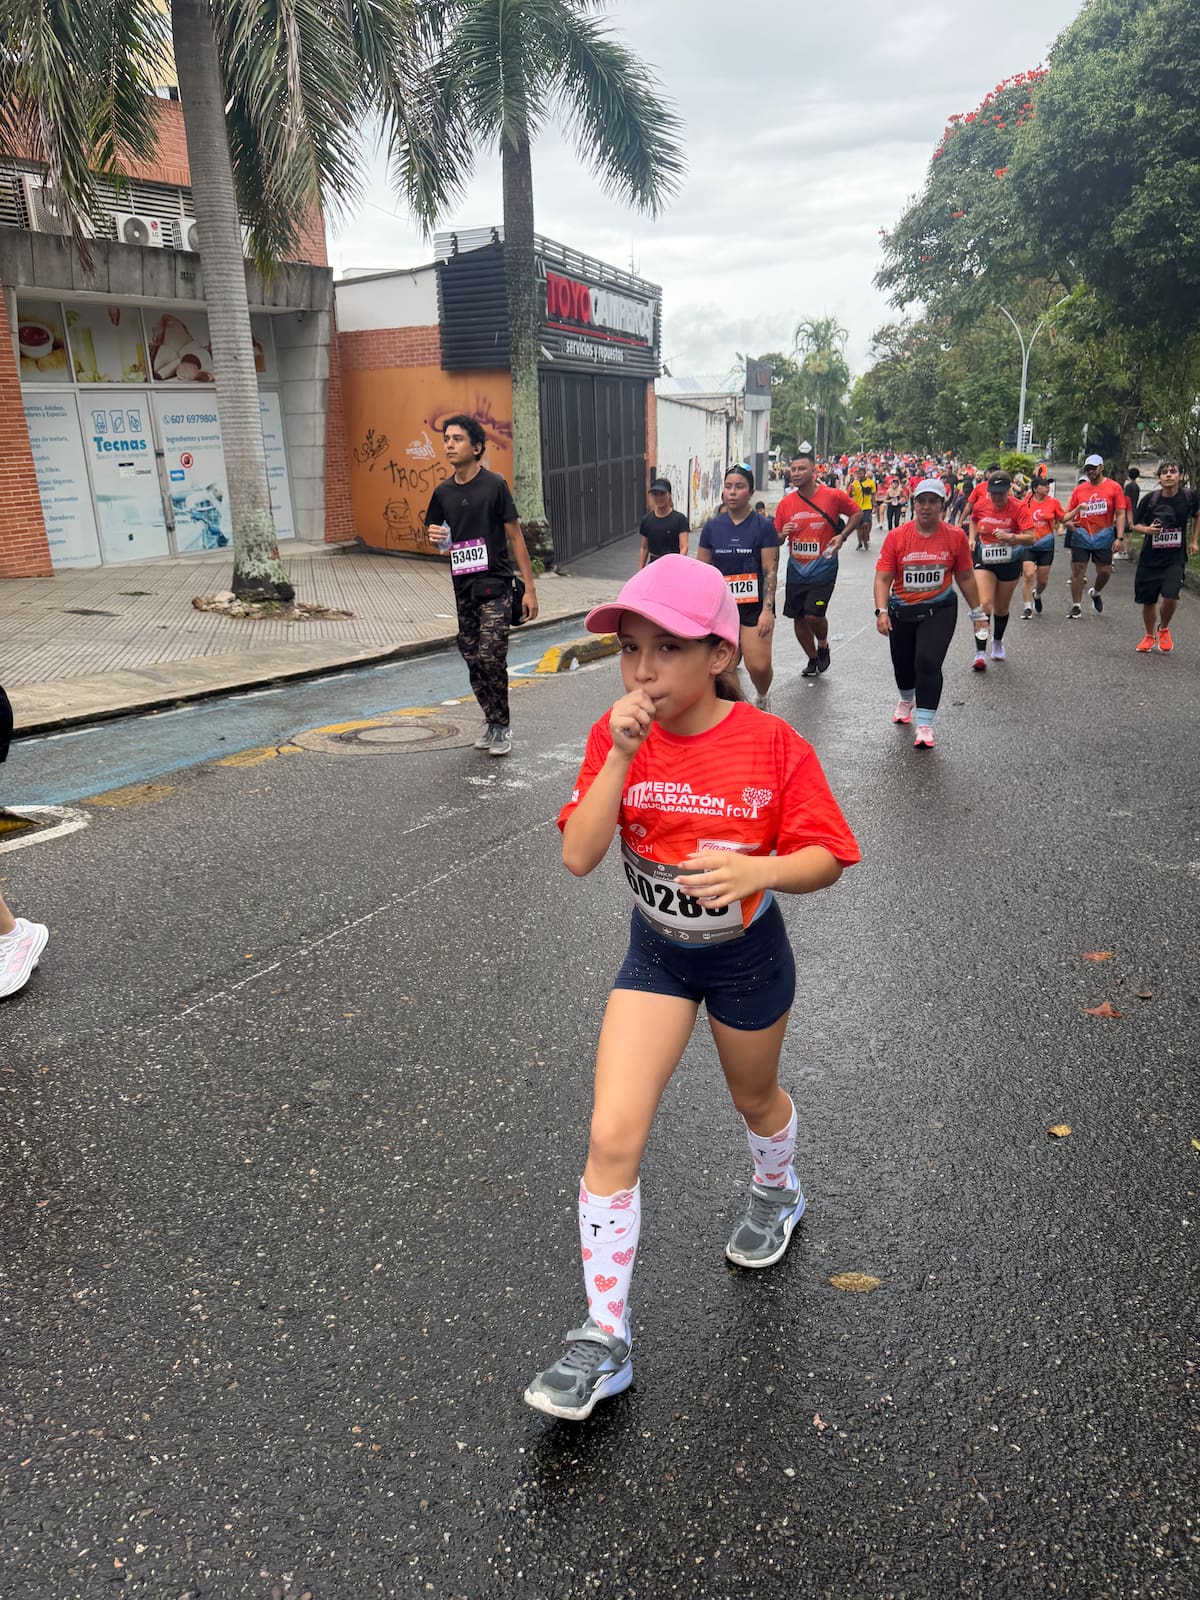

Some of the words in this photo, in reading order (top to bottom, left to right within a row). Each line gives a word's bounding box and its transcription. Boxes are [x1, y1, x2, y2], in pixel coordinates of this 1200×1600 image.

[171, 414, 185, 424] 607
[93, 436, 147, 452] Tecnas
[1154, 532, 1178, 542] 54074
[793, 542, 818, 552] 50019
[985, 547, 1008, 558] 61115
[452, 547, 484, 565] 53492
[905, 571, 941, 584] 61006
[728, 581, 753, 593] 1126
[645, 781, 693, 794] MEDIA
[641, 793, 725, 809] MARATÓN
[640, 802, 724, 817] BUCARAMANGA
[726, 804, 751, 818] fcv
